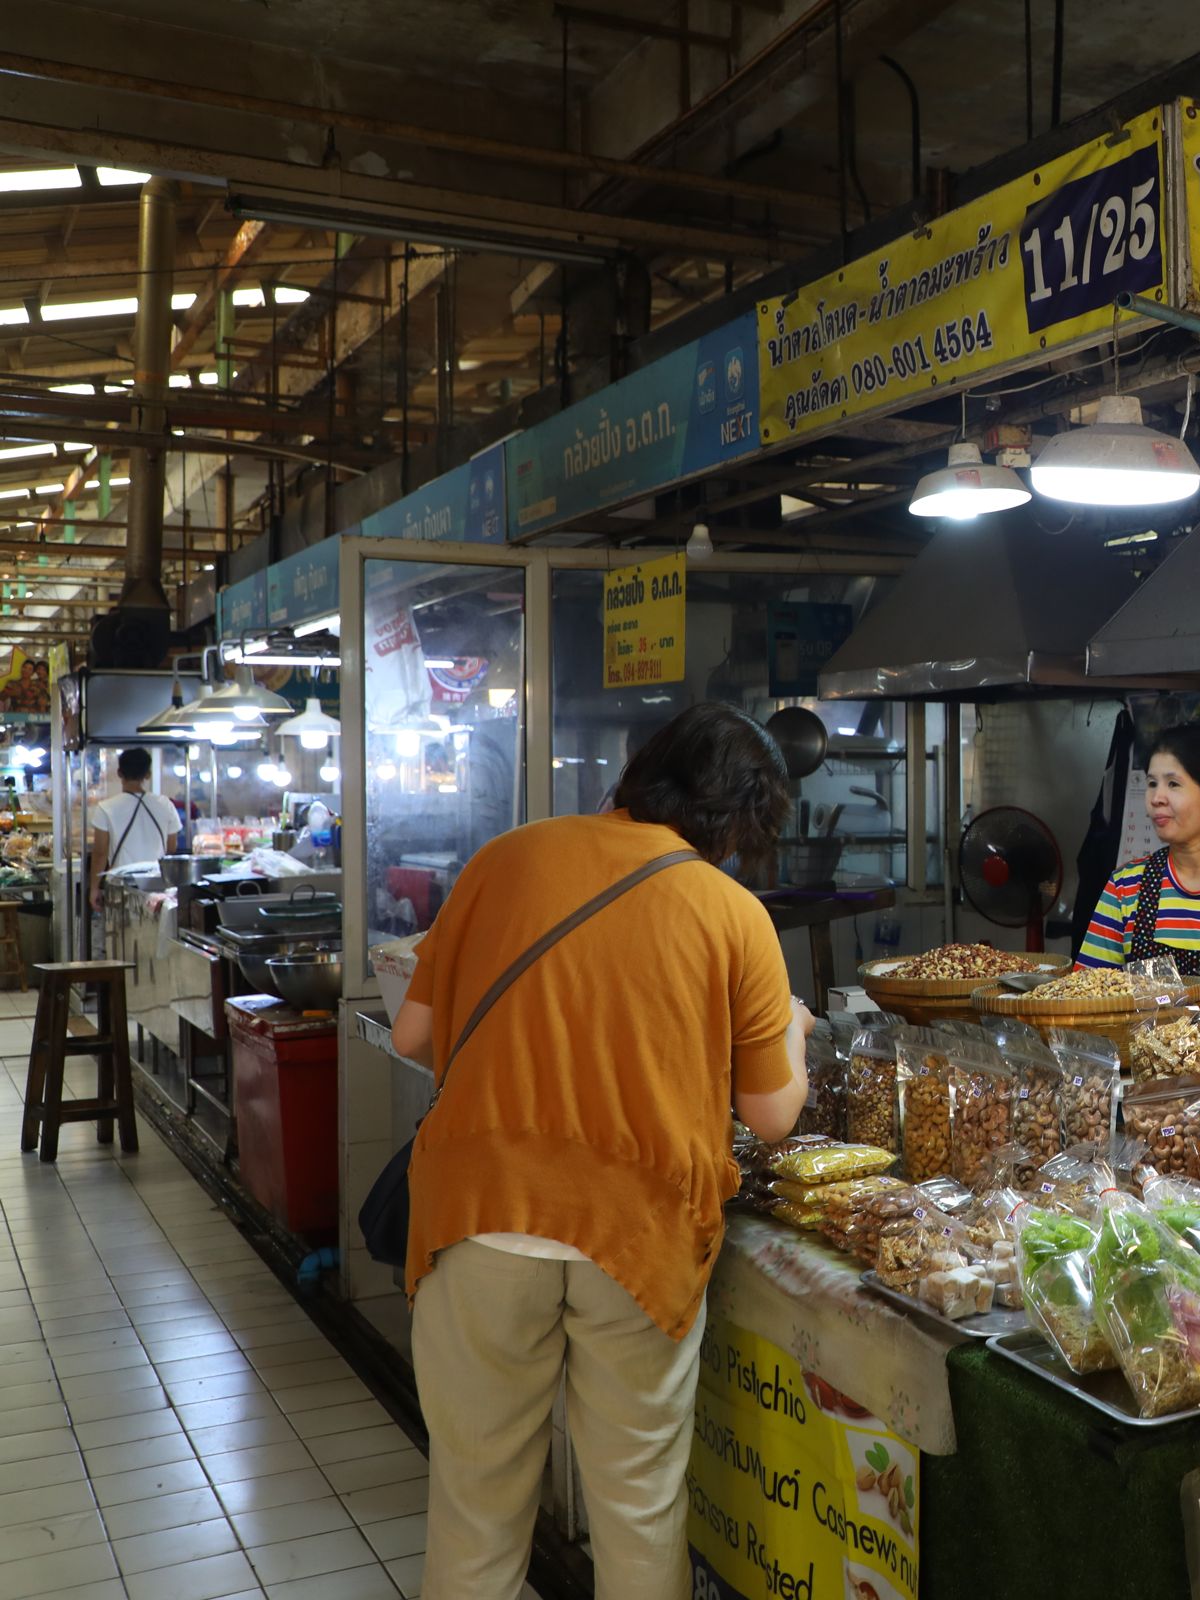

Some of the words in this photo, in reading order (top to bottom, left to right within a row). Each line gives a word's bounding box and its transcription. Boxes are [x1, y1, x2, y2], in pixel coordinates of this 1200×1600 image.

[1024, 176, 1158, 305] 11/25
[783, 367, 849, 431] คุณลัดดา
[851, 338, 931, 397] 080-601
[933, 309, 993, 366] 4564
[563, 407, 621, 480] กล้วยปิ้ง
[720, 411, 753, 446] NEXT
